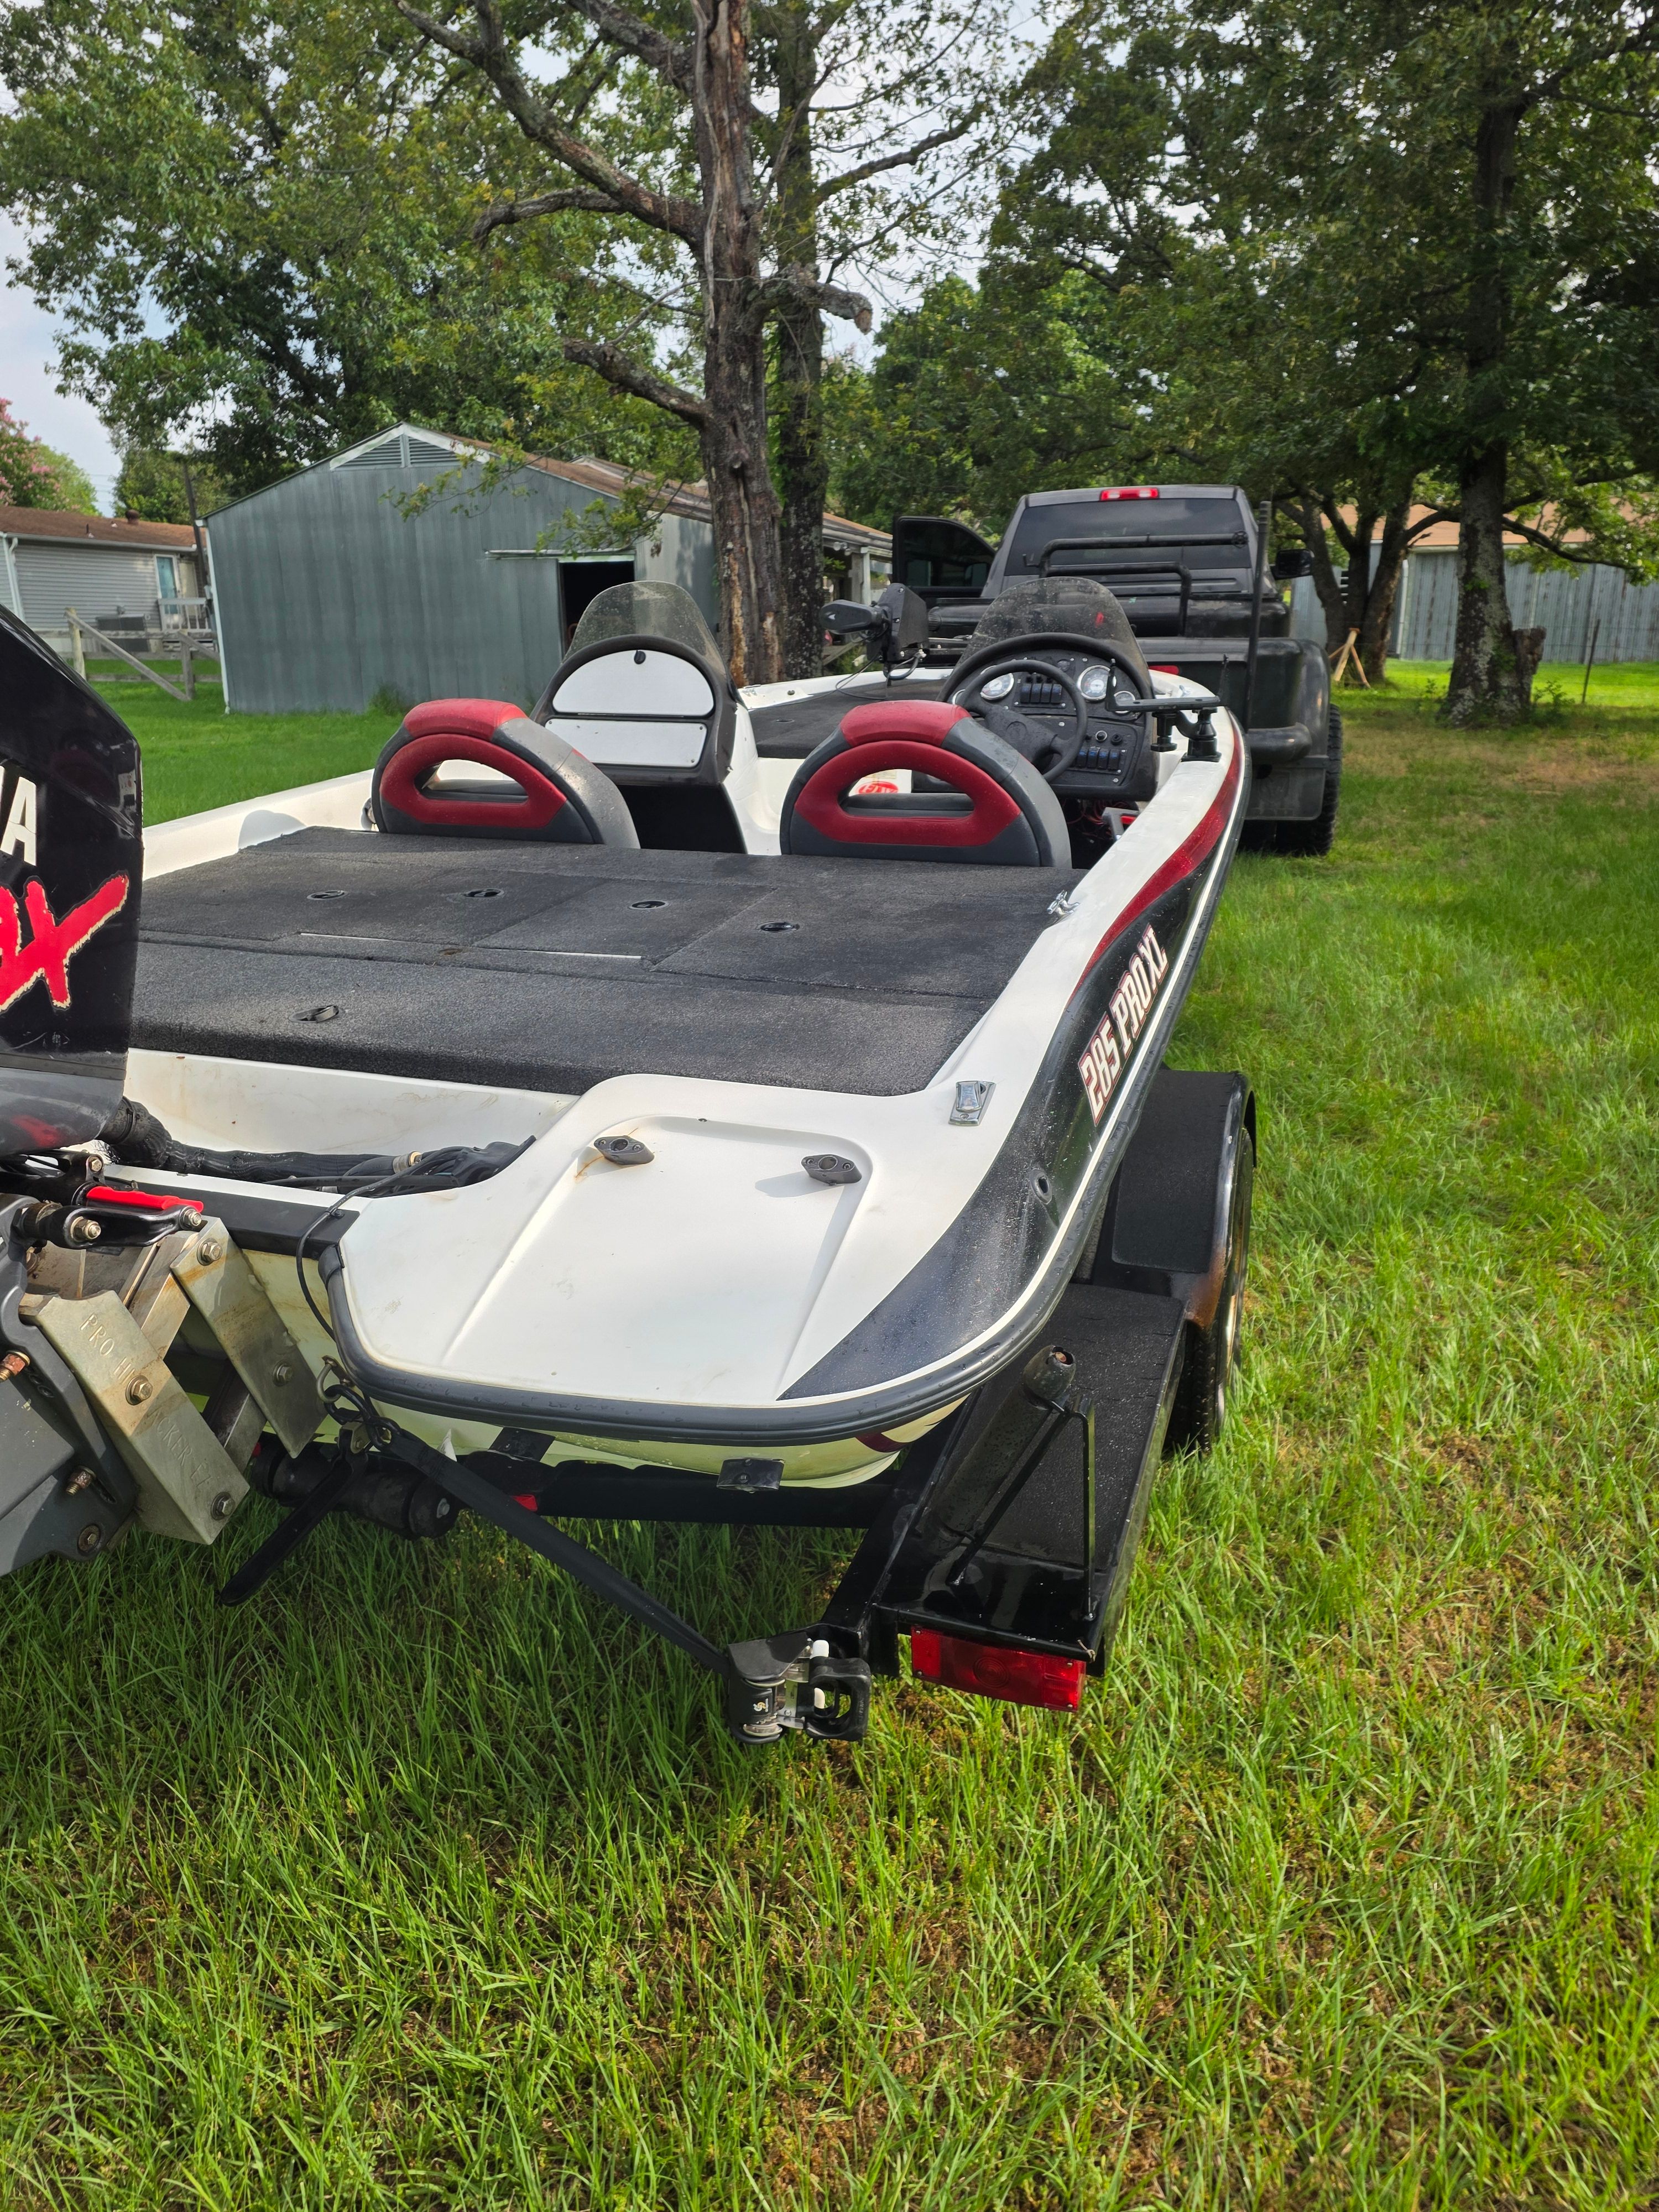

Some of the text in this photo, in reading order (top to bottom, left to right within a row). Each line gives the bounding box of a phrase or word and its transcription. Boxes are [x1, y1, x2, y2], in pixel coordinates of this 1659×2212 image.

[0, 765, 37, 867] A
[1078, 1013, 1121, 1126] 285
[80, 1313, 115, 1356] PRO
